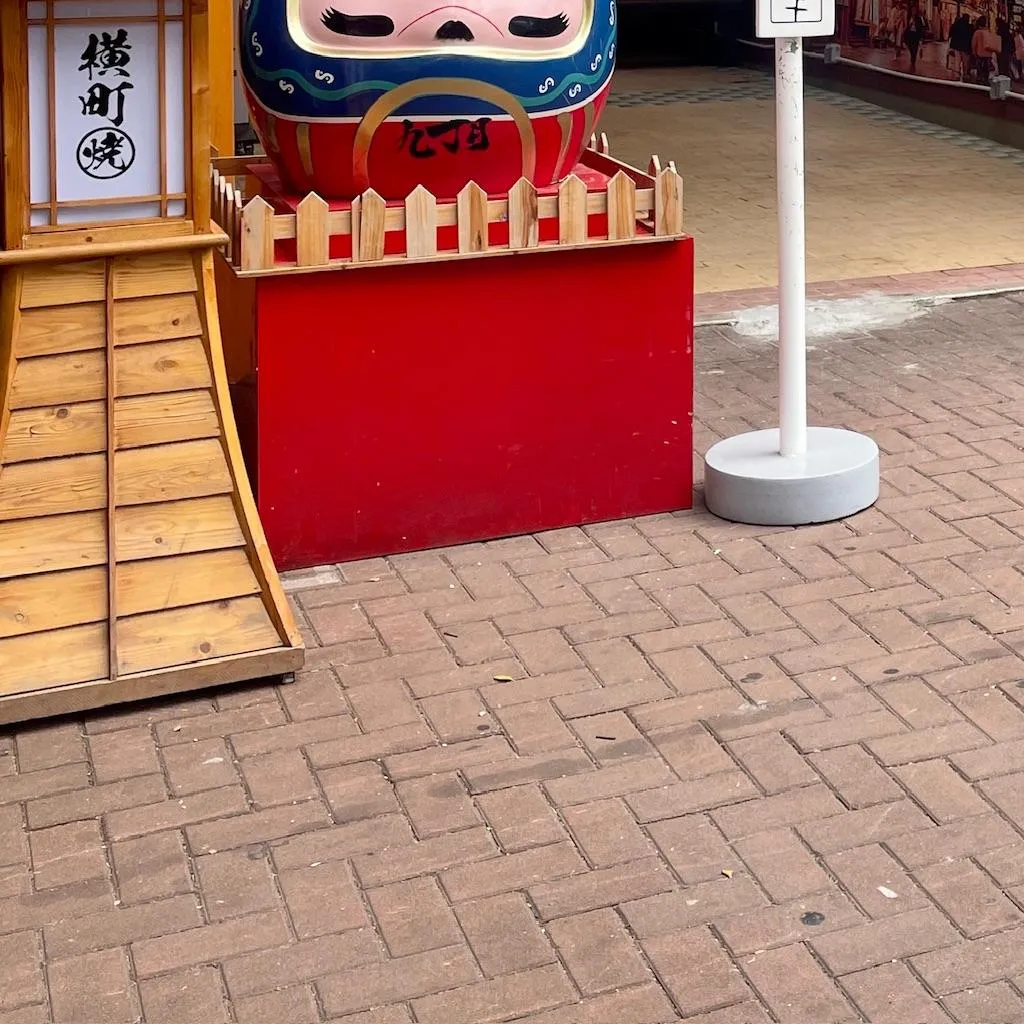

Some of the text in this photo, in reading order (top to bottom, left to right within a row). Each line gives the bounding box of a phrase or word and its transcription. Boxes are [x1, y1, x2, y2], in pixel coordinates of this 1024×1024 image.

[78, 28, 133, 176] 横町 焼
[401, 117, 491, 158] 九丁目
